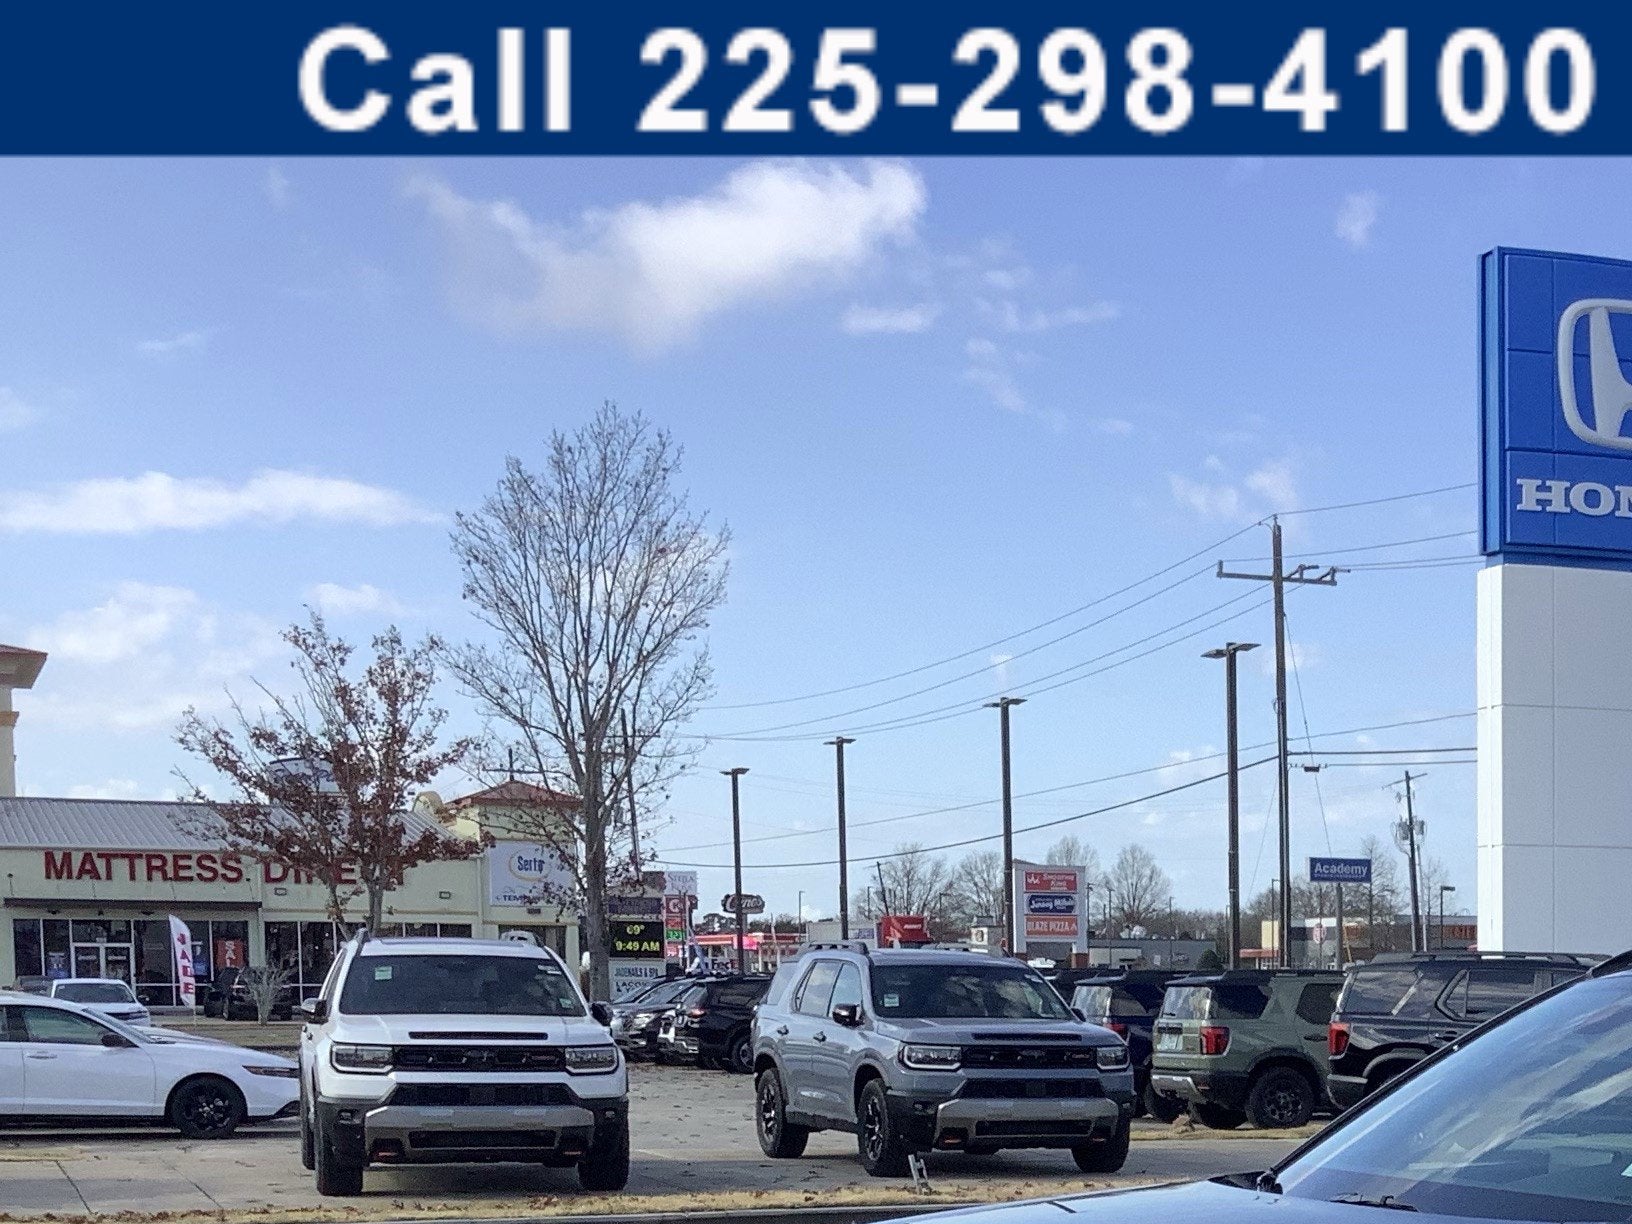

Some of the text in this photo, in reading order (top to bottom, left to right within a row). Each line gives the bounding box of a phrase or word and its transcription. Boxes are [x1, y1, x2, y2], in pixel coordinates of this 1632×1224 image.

[44, 851, 243, 882] MATTRESS
[1314, 862, 1368, 877] Academy
[615, 941, 660, 951] 9:49 AM
